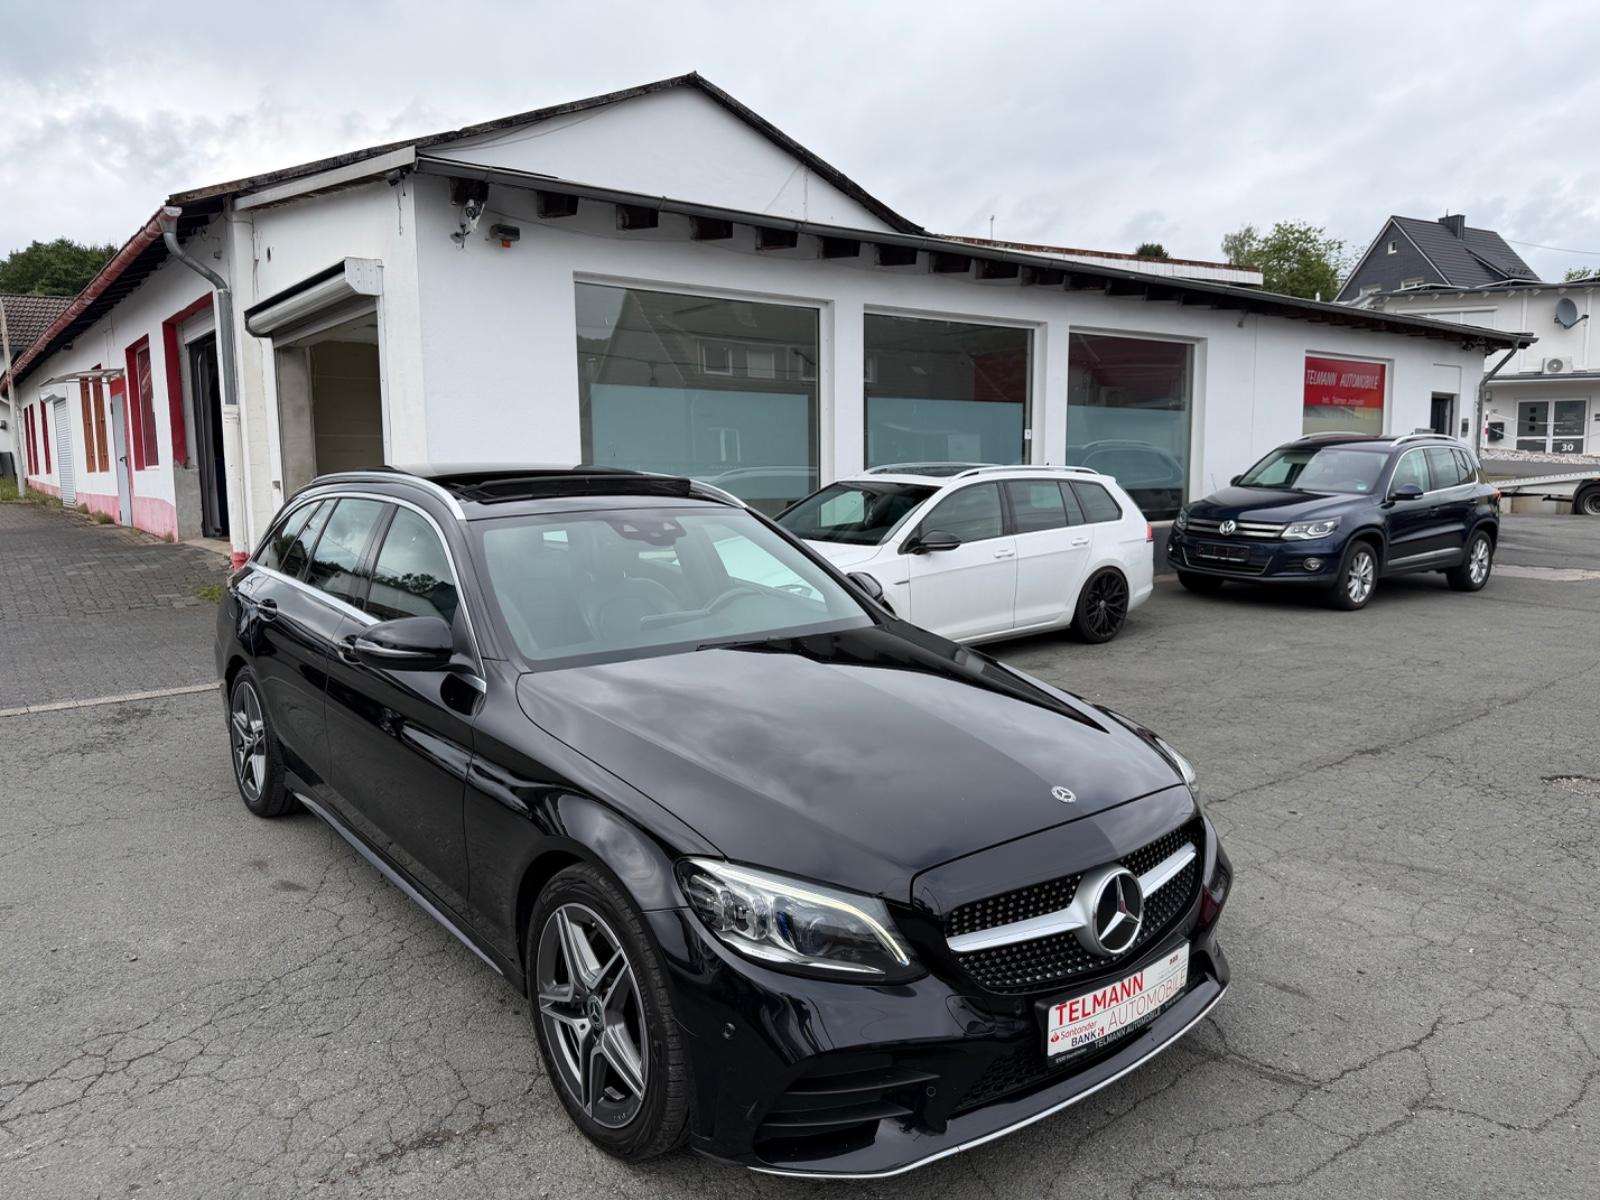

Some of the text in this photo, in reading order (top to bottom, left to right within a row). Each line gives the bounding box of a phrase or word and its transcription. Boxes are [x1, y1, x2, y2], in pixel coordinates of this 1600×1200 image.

[1305, 369, 1379, 390] TELMANN AUTOMOBILE
[1561, 443, 1574, 452] 30
[1055, 970, 1144, 1026] TELMANN
[1107, 967, 1186, 1031] AUTOMOBILE
[1060, 1021, 1097, 1041] Santander
[1094, 1026, 1126, 1049] TELMANN
